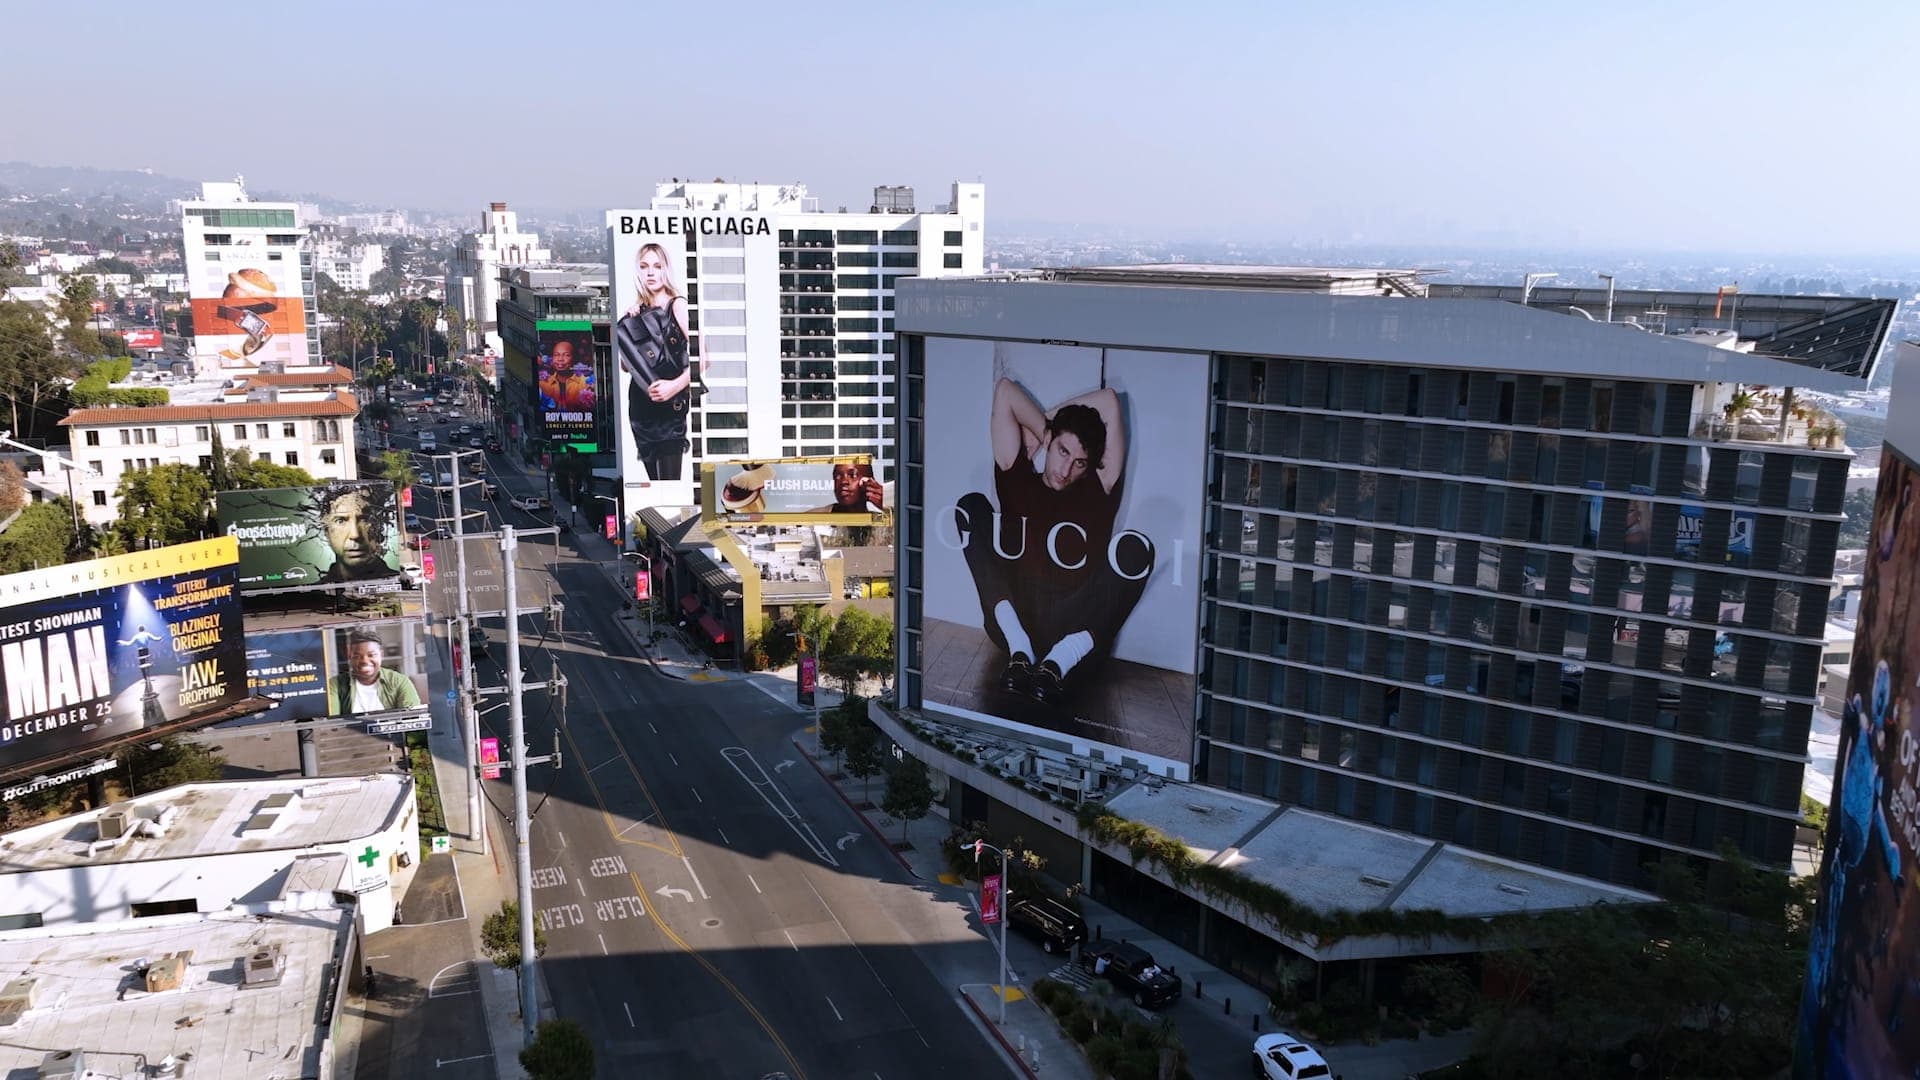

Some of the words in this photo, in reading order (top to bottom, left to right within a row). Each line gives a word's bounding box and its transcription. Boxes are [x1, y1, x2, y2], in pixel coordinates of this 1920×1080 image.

[620, 215, 771, 236] BALENCIAGA
[545, 412, 560, 422] ROY
[561, 412, 583, 422] WOOD
[584, 412, 593, 422] JR
[764, 479, 800, 491] FLUSH
[802, 479, 834, 491] BALM
[226, 521, 306, 544] Goosebumps
[933, 504, 1184, 587] GUCCI
[72, 559, 161, 584] MUSICAL
[179, 548, 223, 564] EVER
[35, 606, 102, 633] SHOWMAN
[1, 624, 111, 720] MAN
[261, 666, 284, 676] was
[286, 663, 317, 673] then.
[269, 677, 289, 686] are
[291, 674, 318, 683] now.
[2, 707, 88, 741] DECEMBER
[96, 700, 113, 717] 25
[372, 721, 428, 733] REGENCY
[590, 855, 628, 878] KEEP
[594, 895, 646, 922] CLEAR
